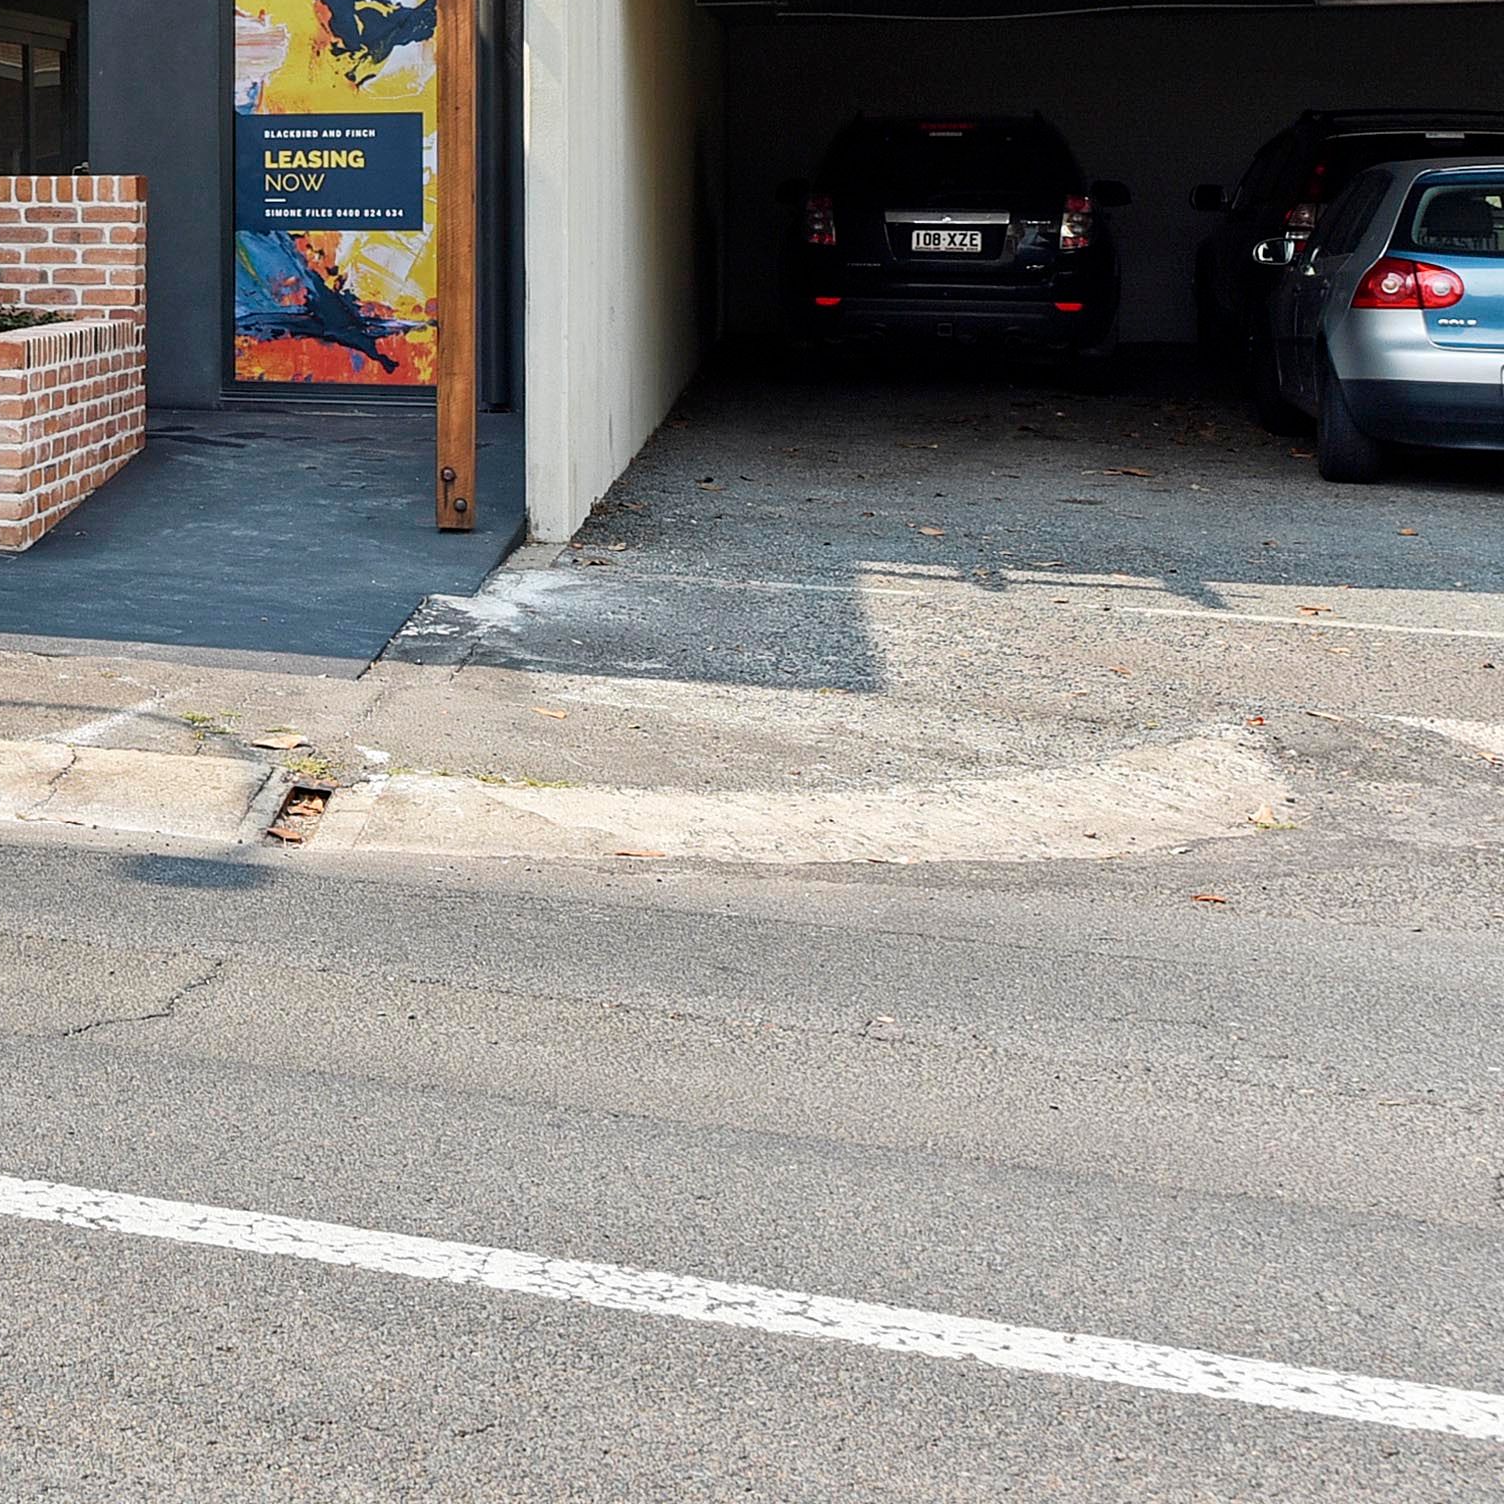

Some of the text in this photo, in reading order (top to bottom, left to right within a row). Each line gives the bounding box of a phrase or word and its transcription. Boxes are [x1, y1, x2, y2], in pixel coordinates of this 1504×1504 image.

[263, 129, 376, 138] BLACKBIRD AND FINCH
[264, 149, 365, 169] LEASING
[264, 173, 325, 192] NOW
[264, 208, 303, 217] SIMONE
[305, 208, 333, 217] FILES
[336, 208, 361, 217] 0400
[385, 208, 404, 217] 634
